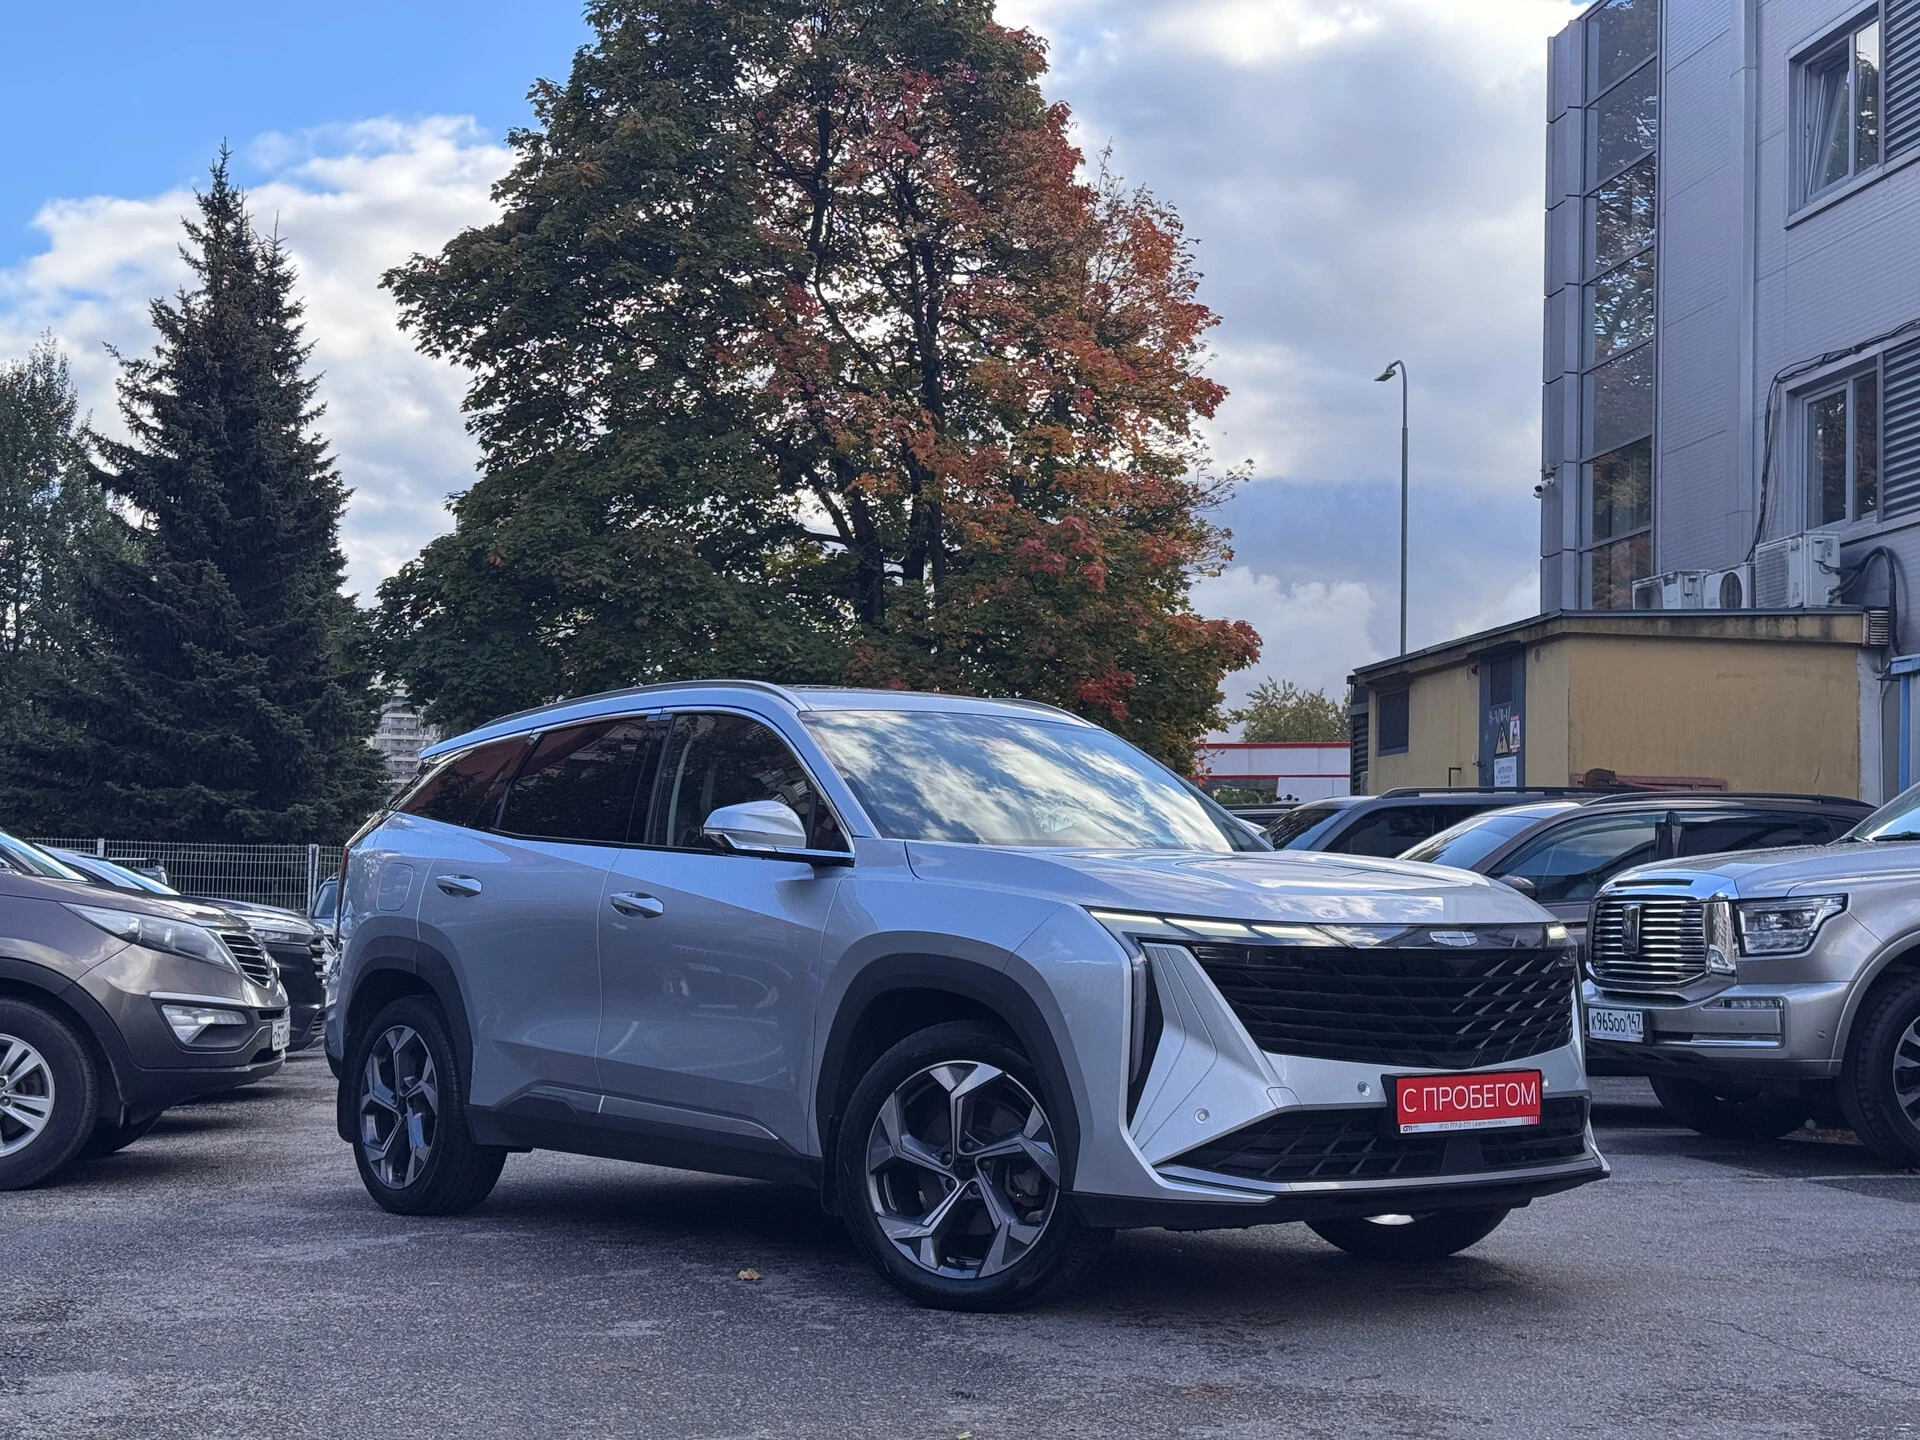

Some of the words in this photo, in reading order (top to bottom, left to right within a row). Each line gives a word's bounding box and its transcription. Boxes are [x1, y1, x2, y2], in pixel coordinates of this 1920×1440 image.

[1627, 1013, 1641, 1029] 147
[1402, 1088, 1418, 1113] С
[1423, 1081, 1537, 1112] ПРОБЕГОМ
